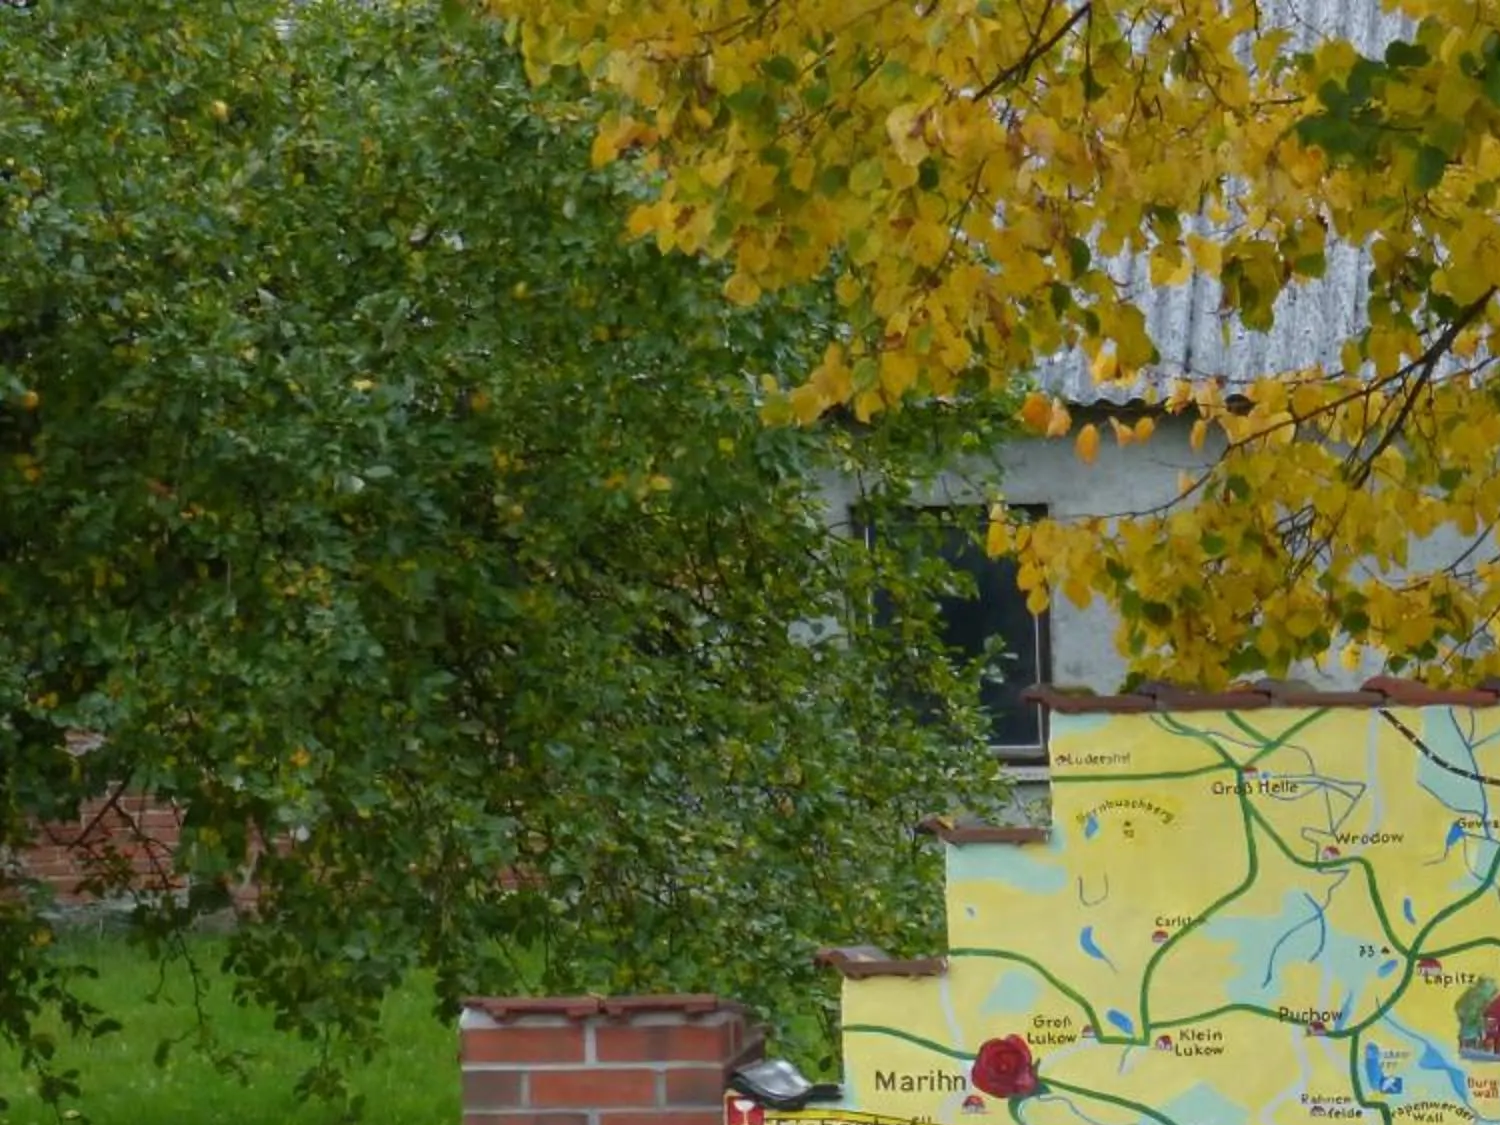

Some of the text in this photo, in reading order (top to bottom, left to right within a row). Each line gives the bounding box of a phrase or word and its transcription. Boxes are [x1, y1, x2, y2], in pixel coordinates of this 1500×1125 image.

[1258, 780, 1299, 795] Helle
[1335, 831, 1404, 846] Wrodow
[1425, 972, 1475, 988] Lapitz
[1279, 1006, 1343, 1023] Puchow
[1033, 1016, 1072, 1029] Groß
[1027, 1032, 1077, 1046] Lukow
[1179, 1029, 1223, 1042] Klein
[1174, 1043, 1225, 1057] Lukow
[874, 1069, 967, 1092] Marihn
